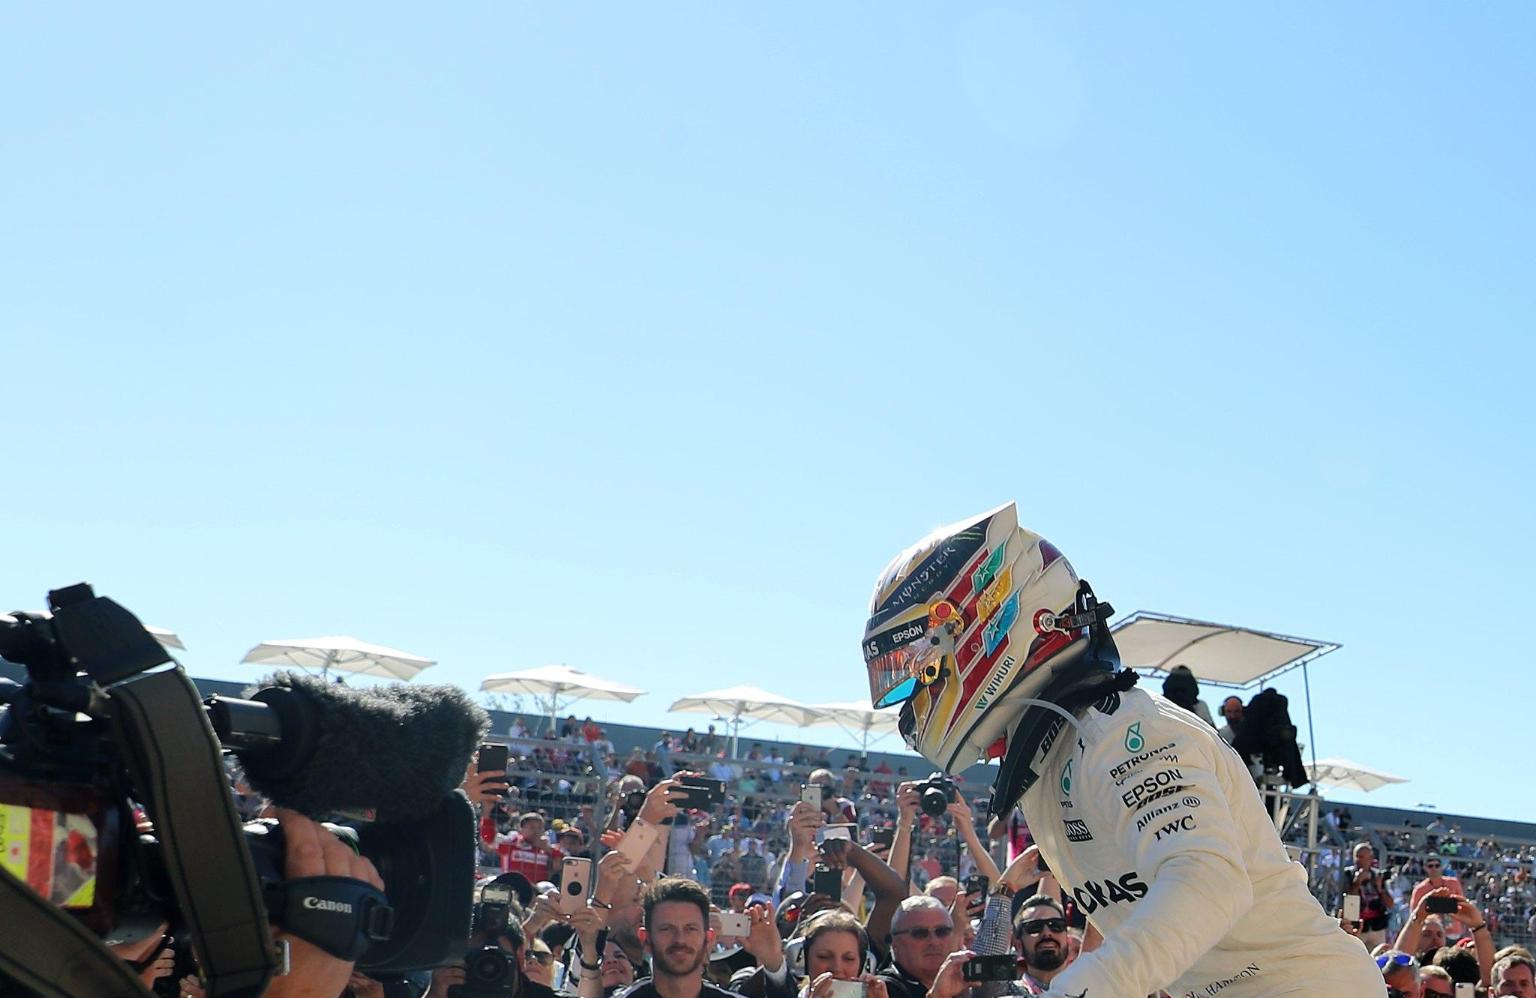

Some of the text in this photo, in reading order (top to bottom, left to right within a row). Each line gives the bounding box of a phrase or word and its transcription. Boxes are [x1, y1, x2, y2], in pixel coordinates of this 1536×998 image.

[892, 625, 924, 644] EPSON
[985, 656, 1016, 697] WIHURI
[1110, 743, 1176, 778] PETRONAS
[1122, 769, 1183, 808] EPSON
[1136, 802, 1180, 832] Allianz
[1154, 816, 1197, 841] IWC
[303, 895, 353, 915] Canon
